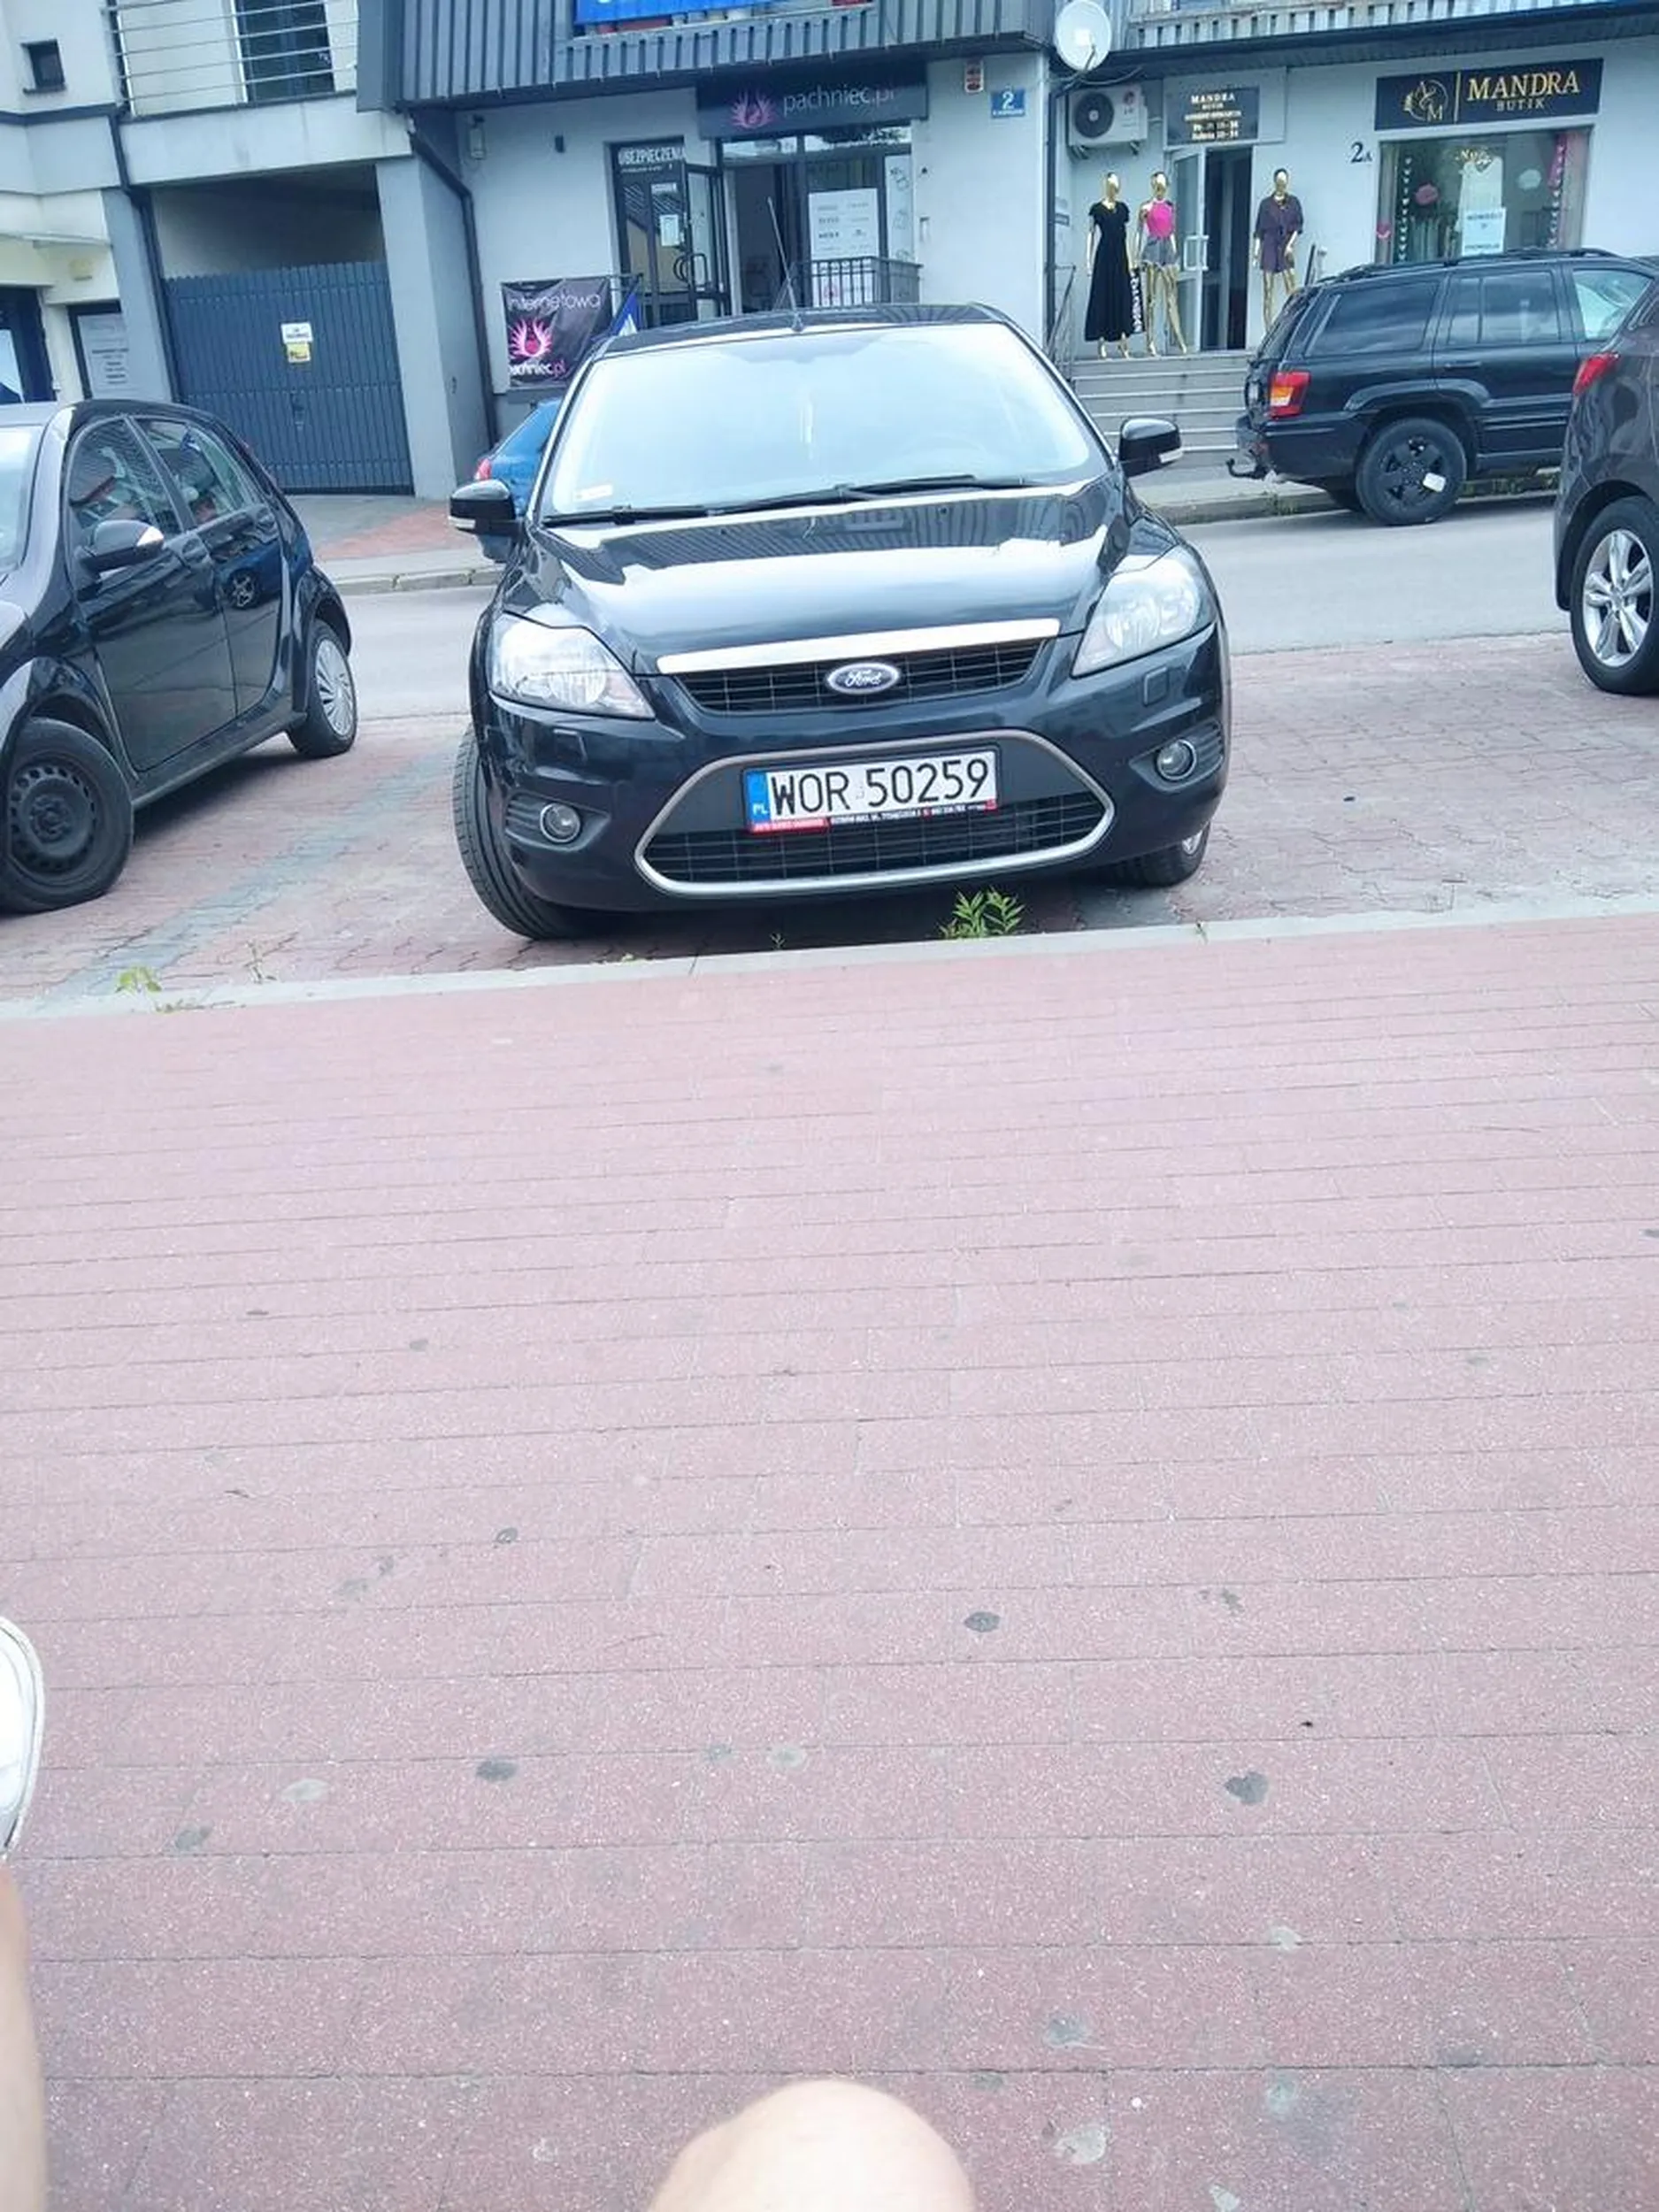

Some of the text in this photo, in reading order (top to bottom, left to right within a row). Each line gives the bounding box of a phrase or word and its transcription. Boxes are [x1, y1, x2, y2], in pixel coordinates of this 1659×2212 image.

[1467, 71, 1580, 102] MANDRA
[783, 83, 896, 117] pachniec.pl
[1002, 91, 1014, 110] 2
[1190, 93, 1236, 104] MANDRA
[1496, 99, 1546, 111] BUTIK
[844, 669, 882, 687] Ford
[771, 757, 989, 816] WOR 50259
[752, 803, 770, 816] PL
